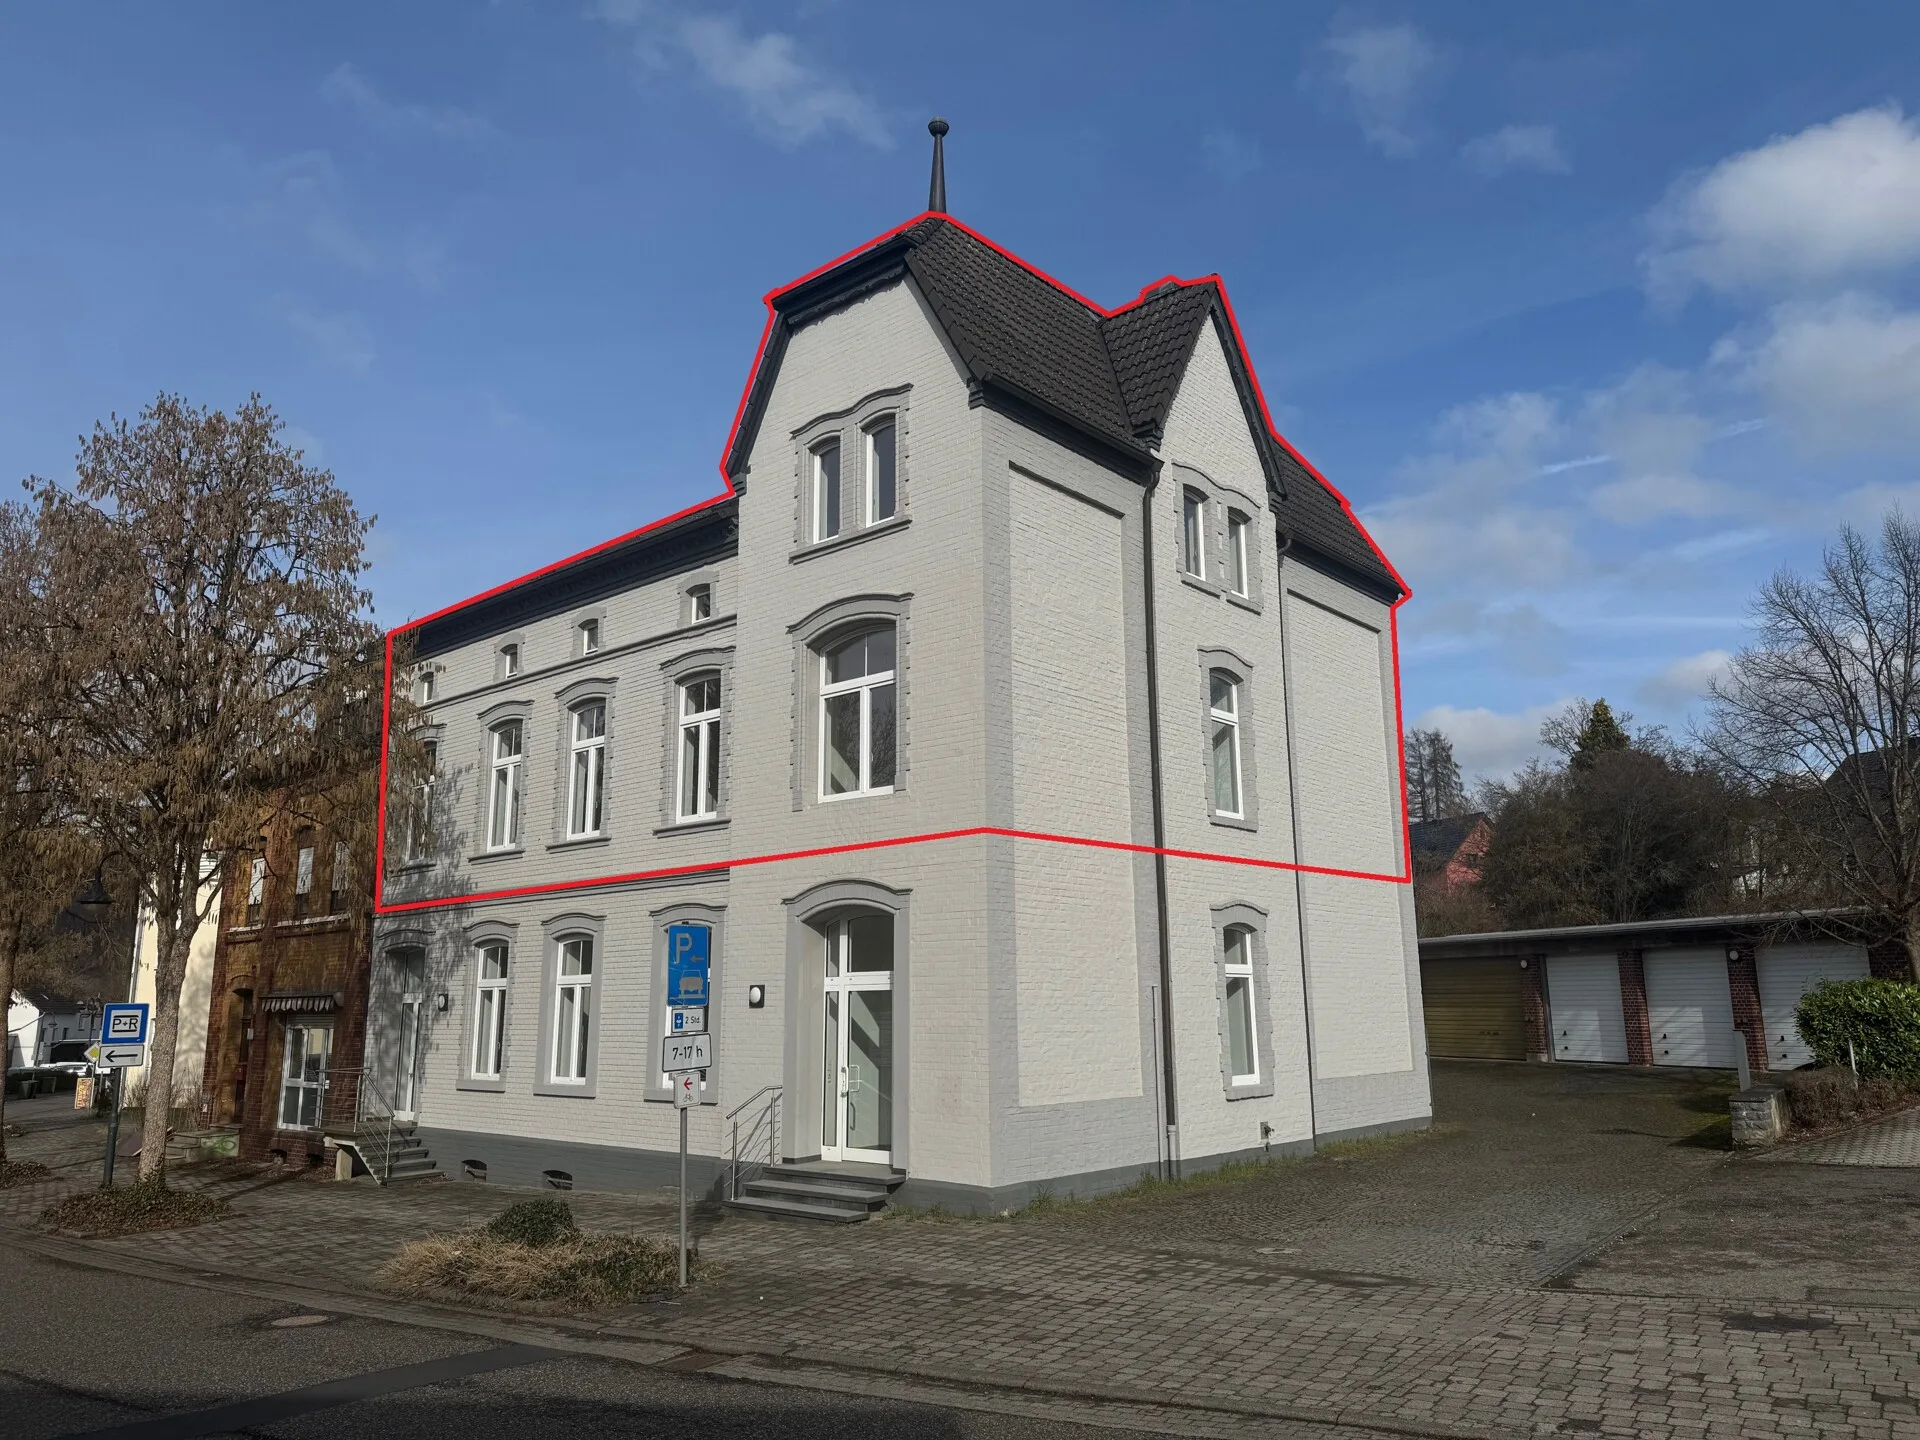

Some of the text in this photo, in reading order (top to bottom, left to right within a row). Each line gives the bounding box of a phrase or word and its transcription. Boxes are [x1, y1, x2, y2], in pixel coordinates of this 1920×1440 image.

[675, 932, 693, 964] P
[112, 1018, 139, 1030] P+R
[685, 1016, 689, 1024] 2
[672, 1045, 703, 1060] 7-17 h
